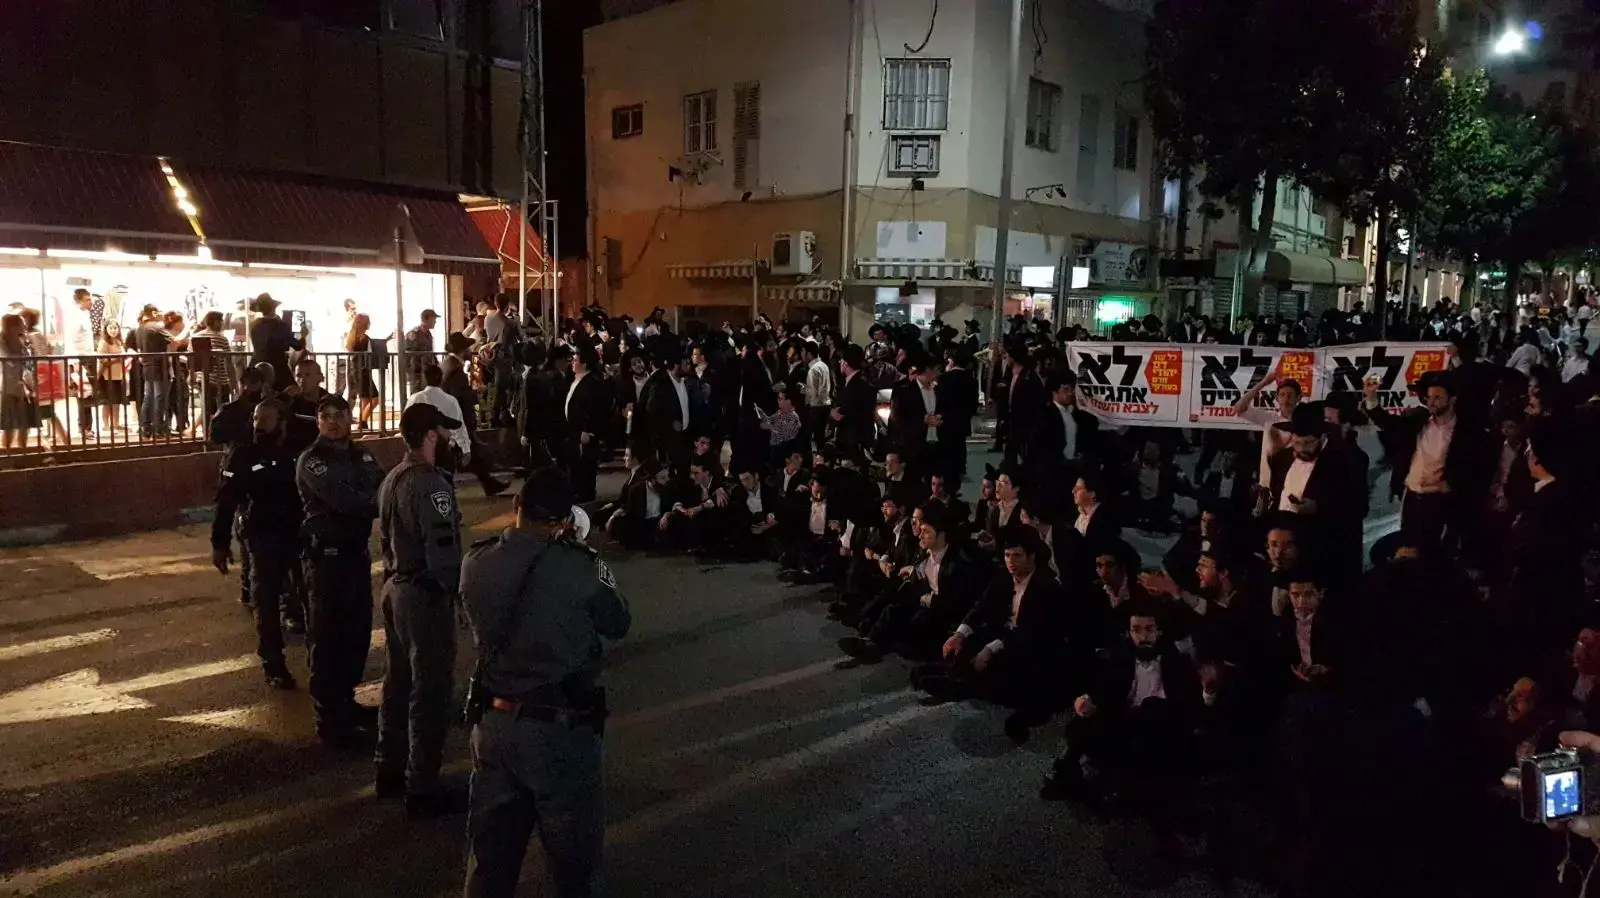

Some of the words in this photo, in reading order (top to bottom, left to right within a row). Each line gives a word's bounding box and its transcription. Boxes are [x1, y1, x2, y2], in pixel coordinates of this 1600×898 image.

[1078, 345, 1143, 386] לא
[1201, 348, 1273, 389] לא
[1331, 346, 1405, 391] לא
